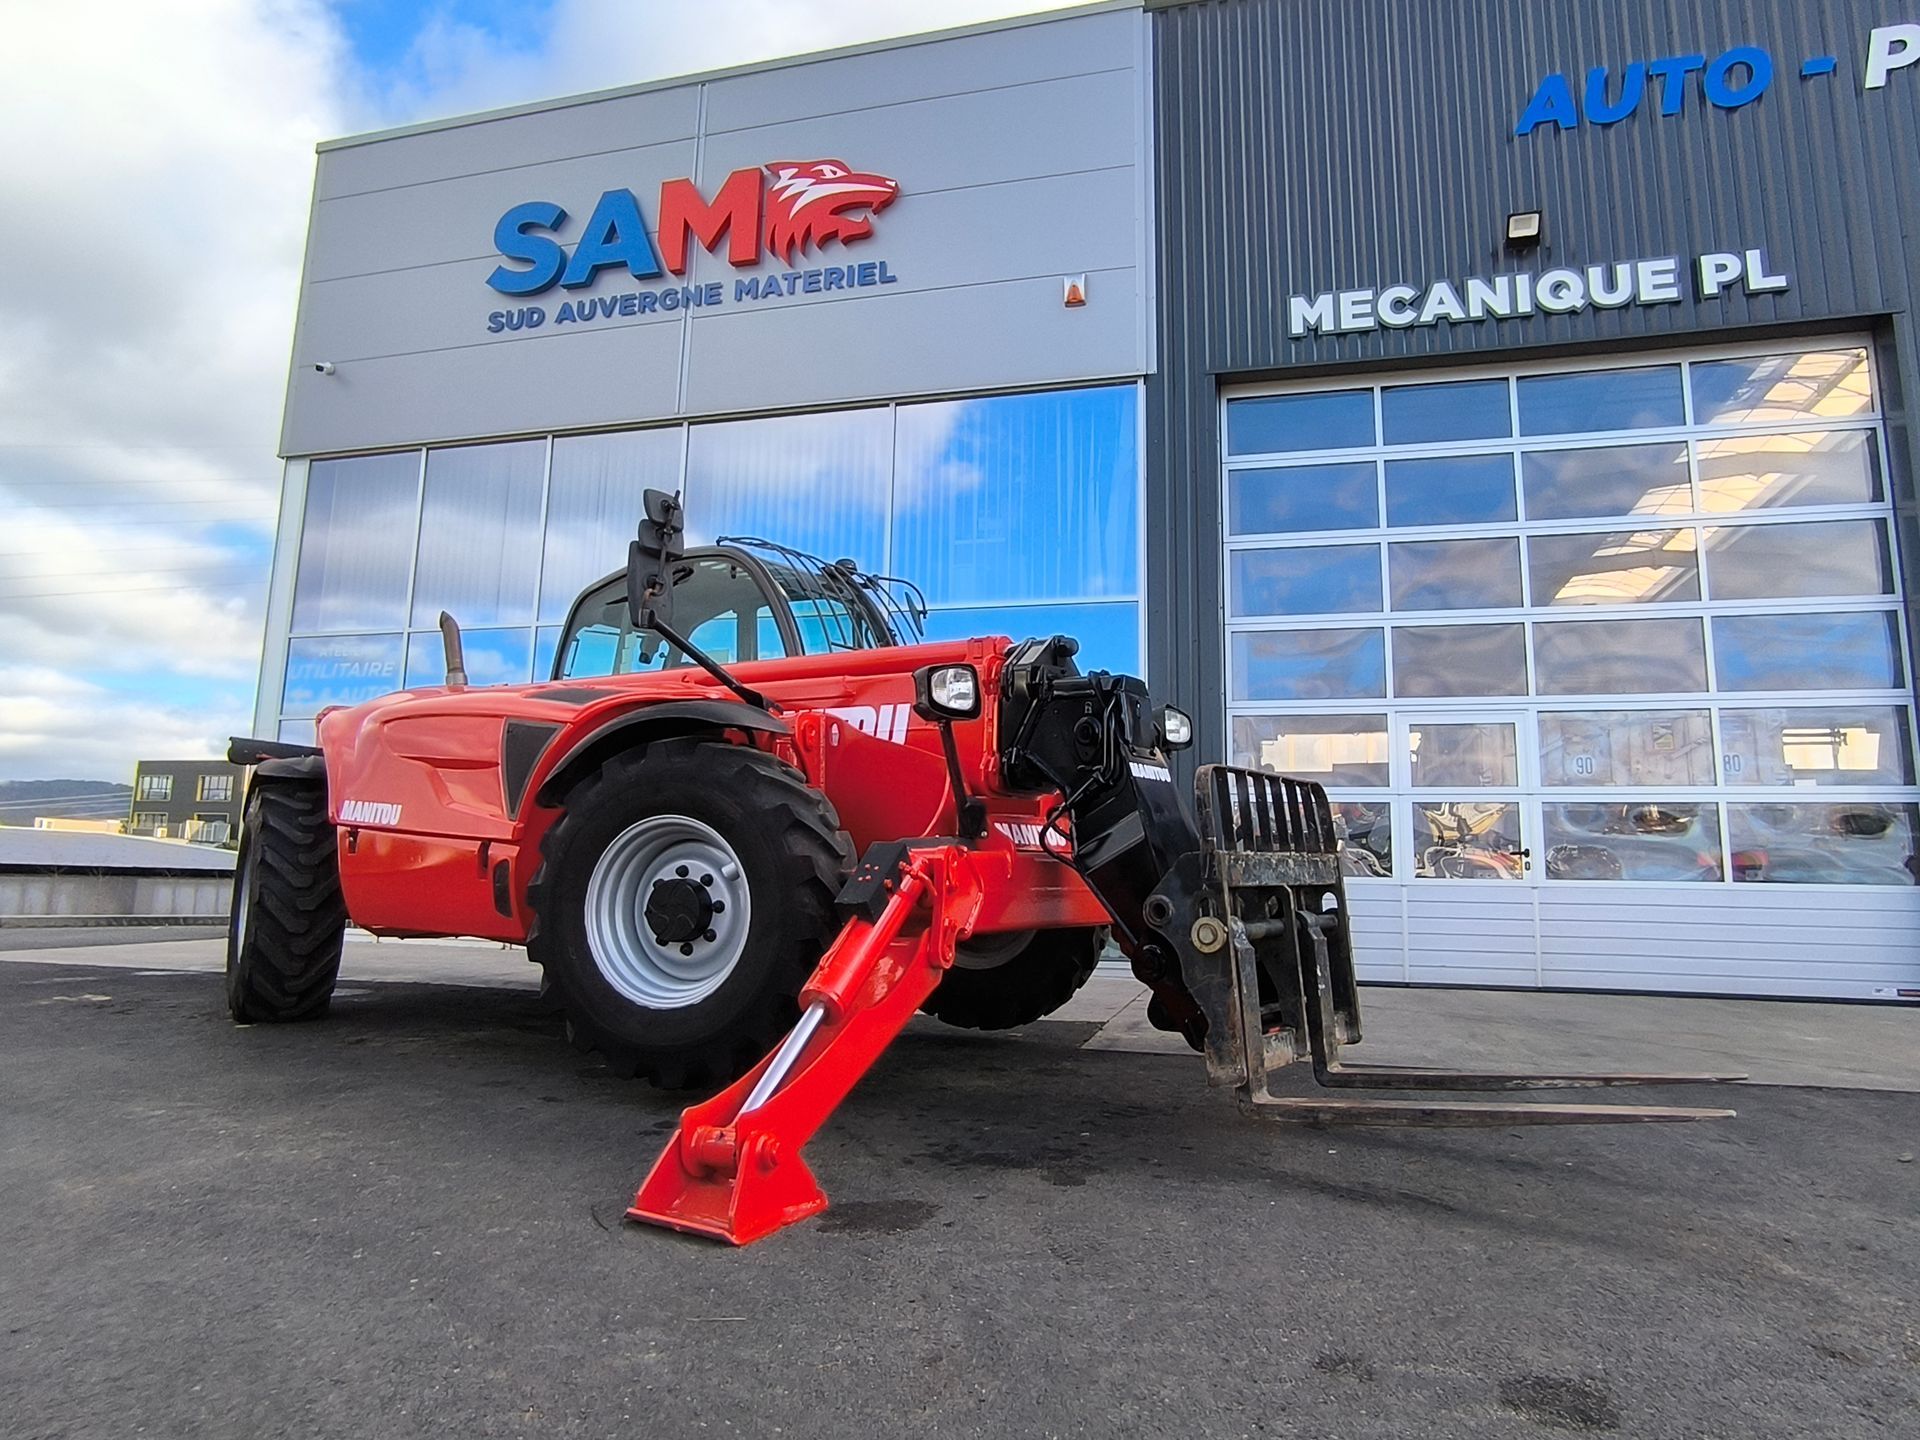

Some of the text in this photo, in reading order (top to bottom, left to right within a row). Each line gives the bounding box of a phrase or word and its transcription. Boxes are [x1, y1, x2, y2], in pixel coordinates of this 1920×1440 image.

[1514, 46, 1773, 136] AUTO
[1802, 55, 1836, 76] -
[485, 166, 764, 297] SAM
[487, 260, 898, 334] SUD AUVERGNE MATERIEL
[1288, 248, 1790, 337] MECANIQUE PL
[289, 661, 396, 680] UTILITAIRE
[1575, 756, 1593, 775] 90
[340, 799, 403, 826] MANITOU
